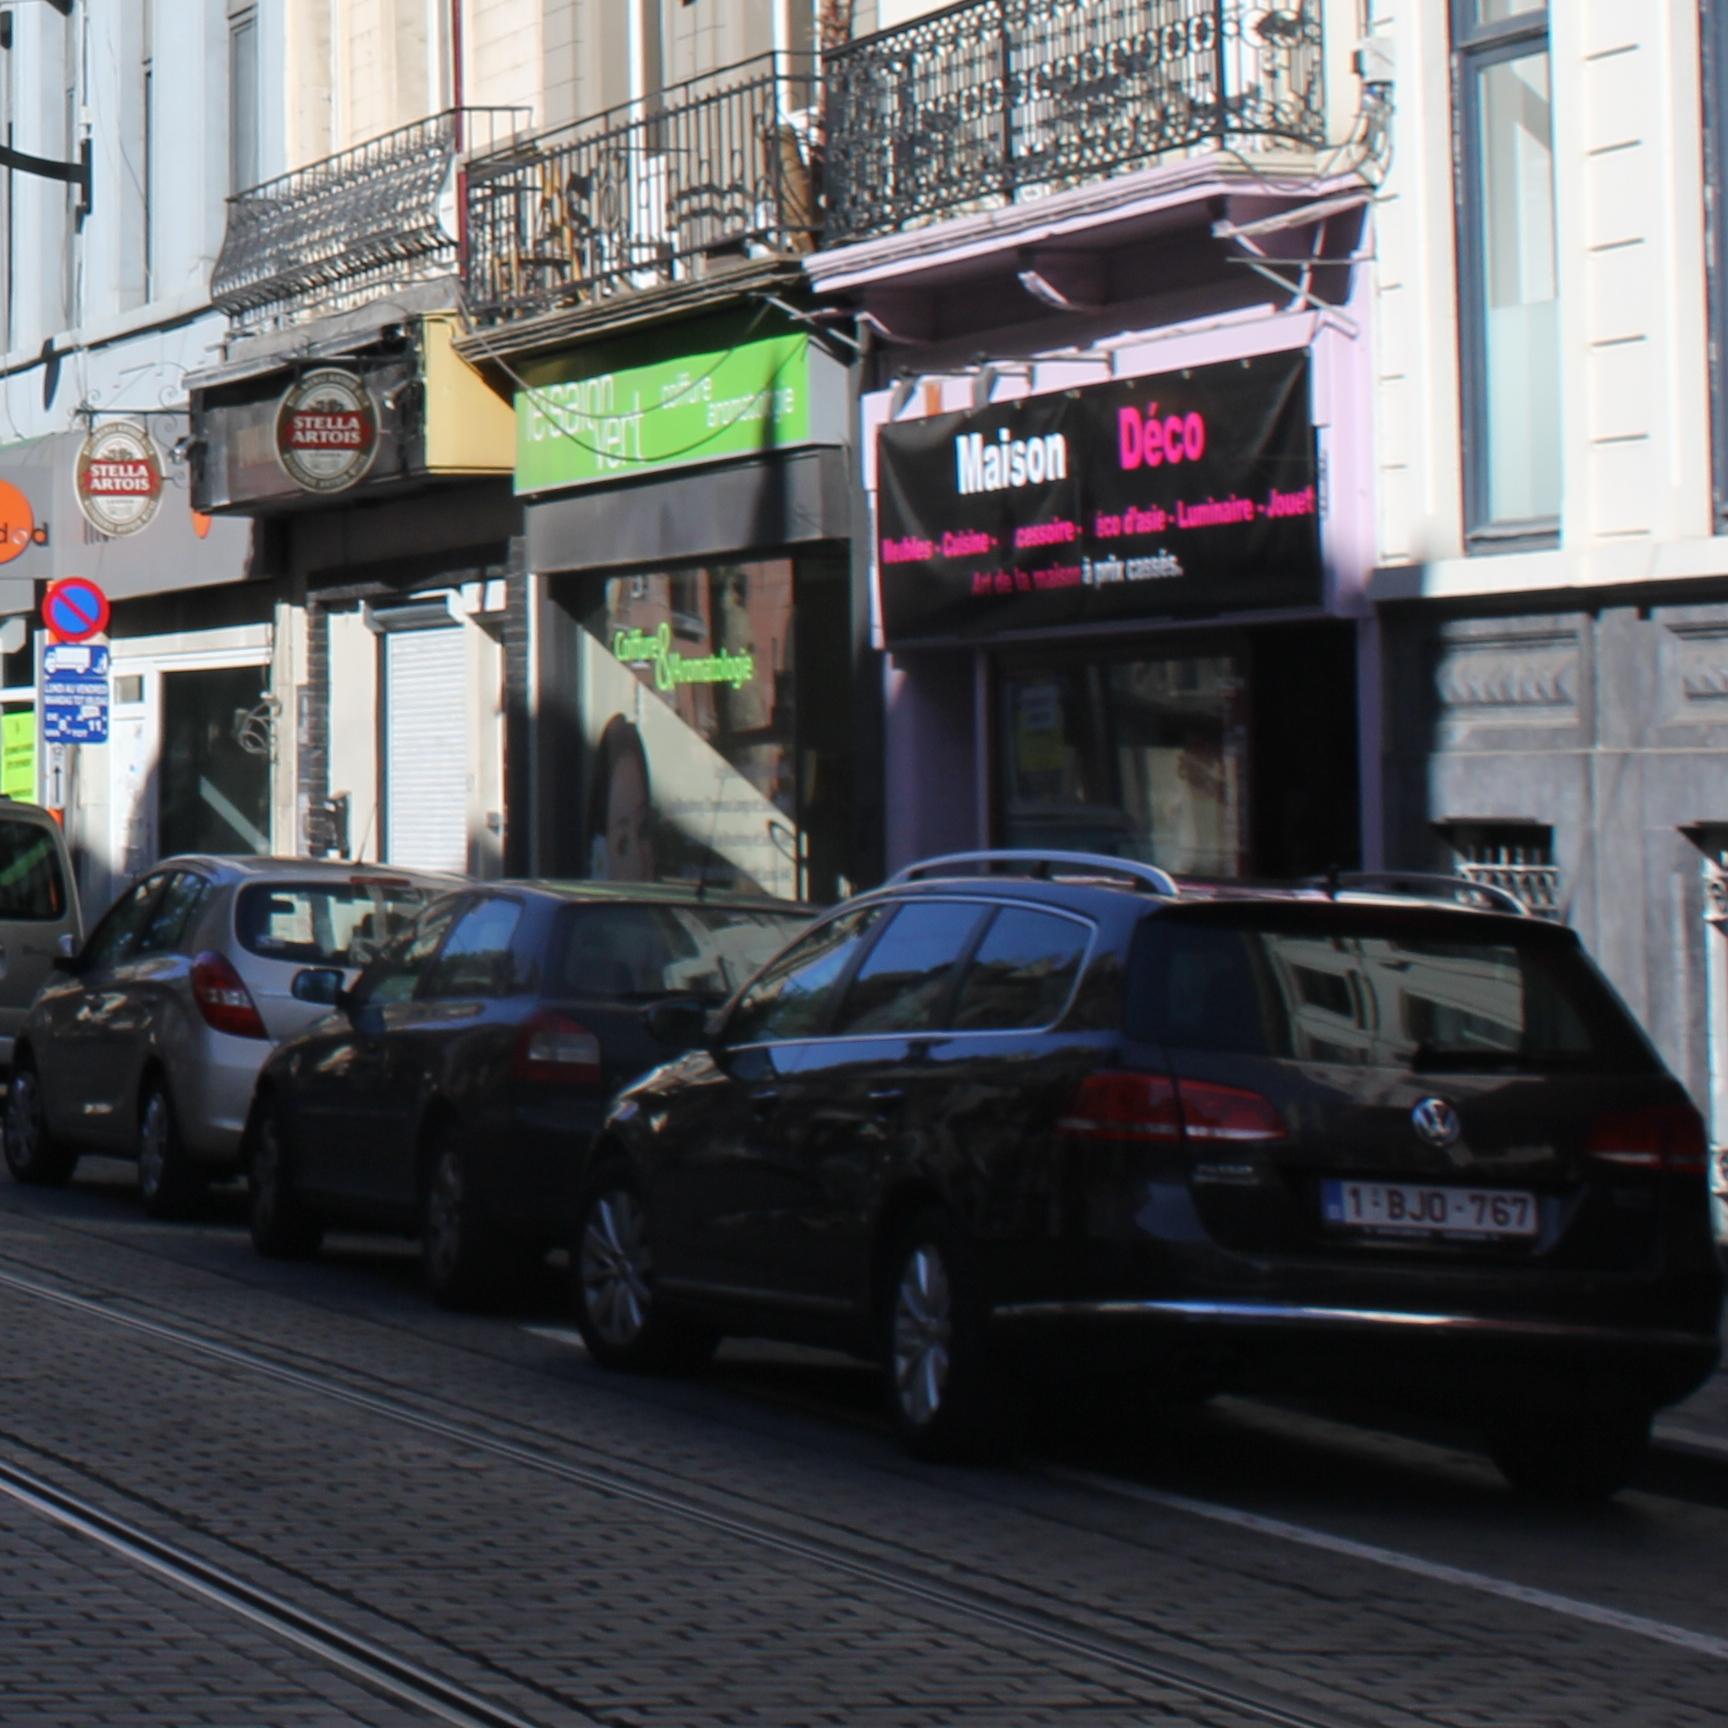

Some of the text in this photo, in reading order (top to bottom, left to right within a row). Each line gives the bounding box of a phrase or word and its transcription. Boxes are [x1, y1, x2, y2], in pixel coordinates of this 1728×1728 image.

[293, 415, 362, 431] STELLA
[293, 429, 362, 445] ARTOIS
[1117, 400, 1206, 471] Déco
[89, 463, 149, 478] STELLA
[956, 427, 1068, 495] Maison
[89, 476, 151, 492] ARTOIS
[942, 529, 990, 559] Cuisine
[1175, 493, 1254, 530] Luminaire
[1032, 562, 1081, 590] maison
[1093, 553, 1125, 590] prix
[614, 628, 659, 661] Coiffure
